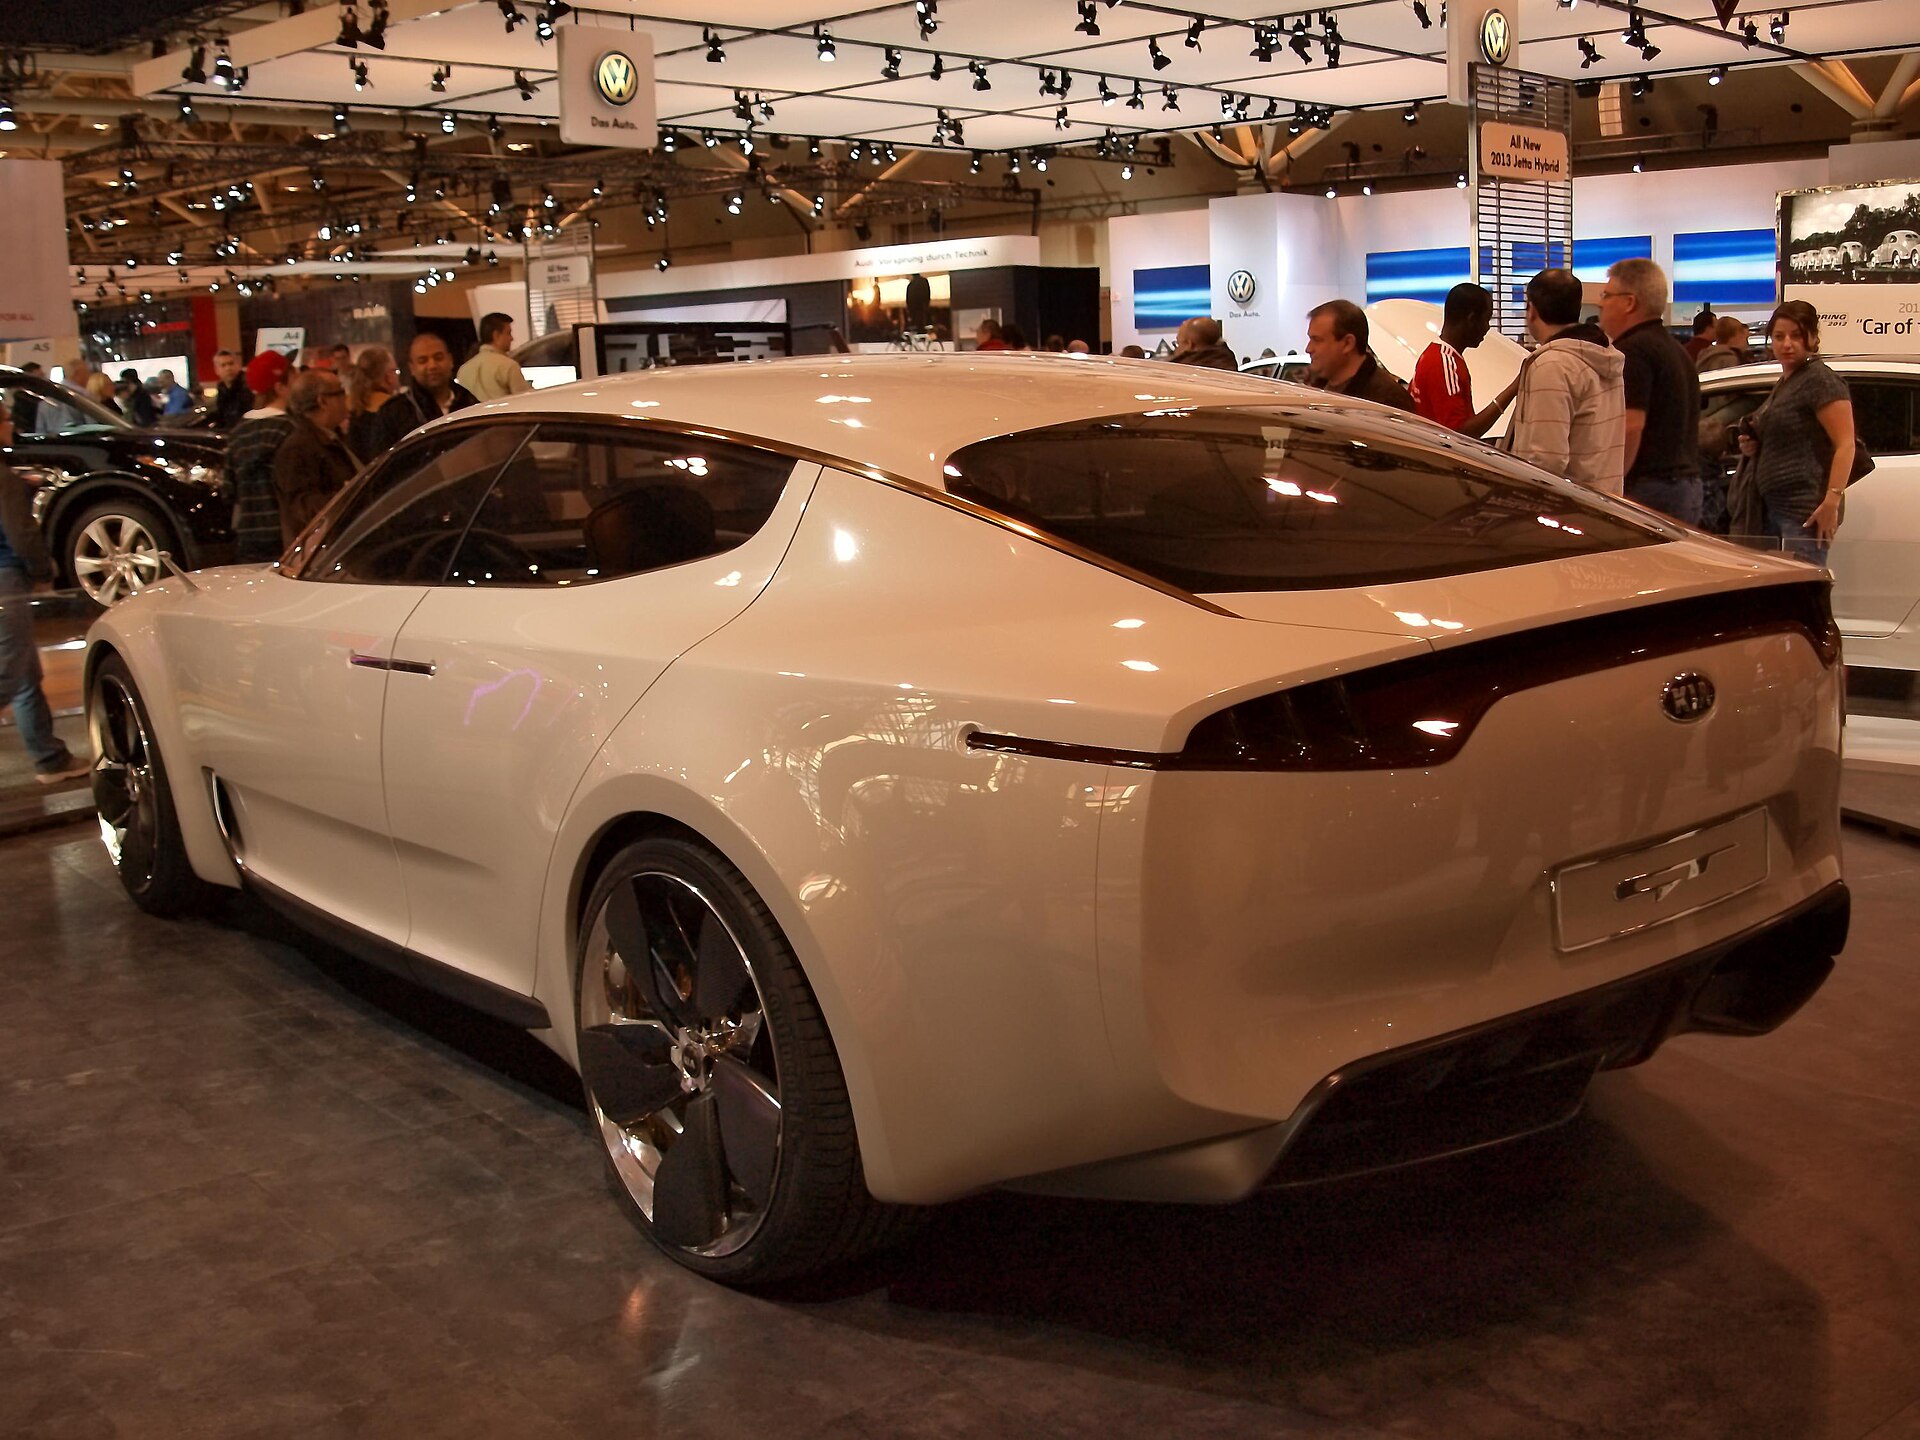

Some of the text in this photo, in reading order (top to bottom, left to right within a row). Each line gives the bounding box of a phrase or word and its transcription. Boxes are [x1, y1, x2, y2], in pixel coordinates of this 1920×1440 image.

[591, 116, 638, 130] Das Auto.
[1510, 135, 1541, 152] All New
[1490, 151, 1560, 174] 2013 Jetta Hybrid
[926, 251, 952, 261] durch
[954, 248, 988, 258] Technik
[1856, 318, 1892, 335] "Car
[1894, 317, 1914, 335] of
